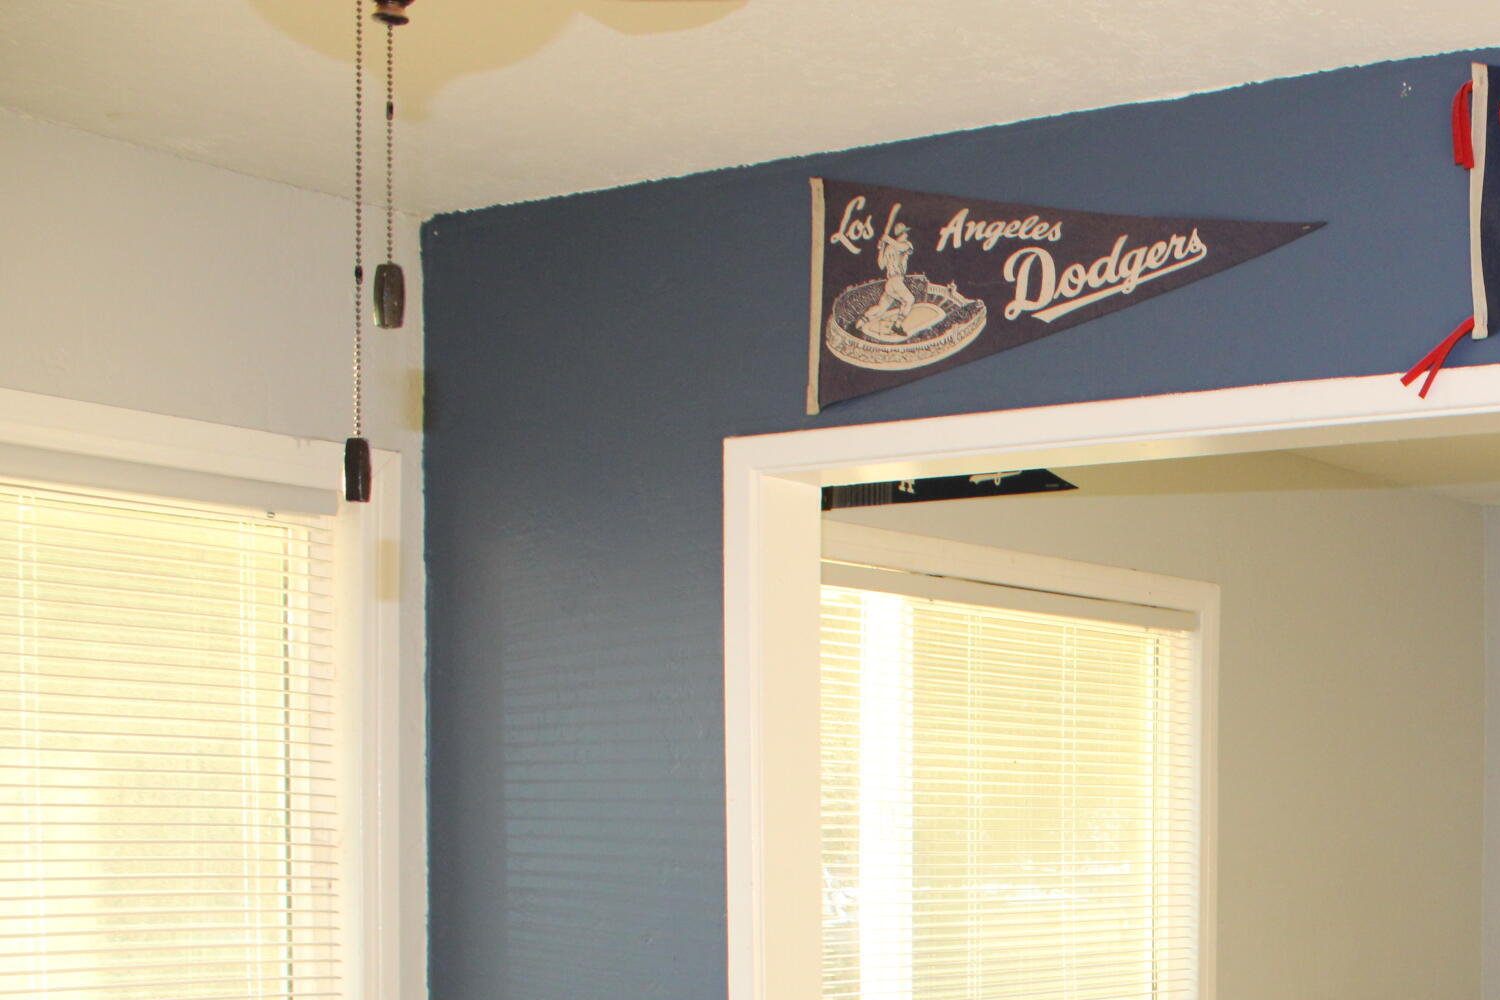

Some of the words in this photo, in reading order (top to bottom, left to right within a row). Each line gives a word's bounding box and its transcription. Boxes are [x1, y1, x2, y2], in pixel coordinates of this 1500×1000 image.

[830, 196, 873, 254] Los
[936, 208, 1063, 252] Angeles
[1003, 227, 1208, 323] Dodgers
